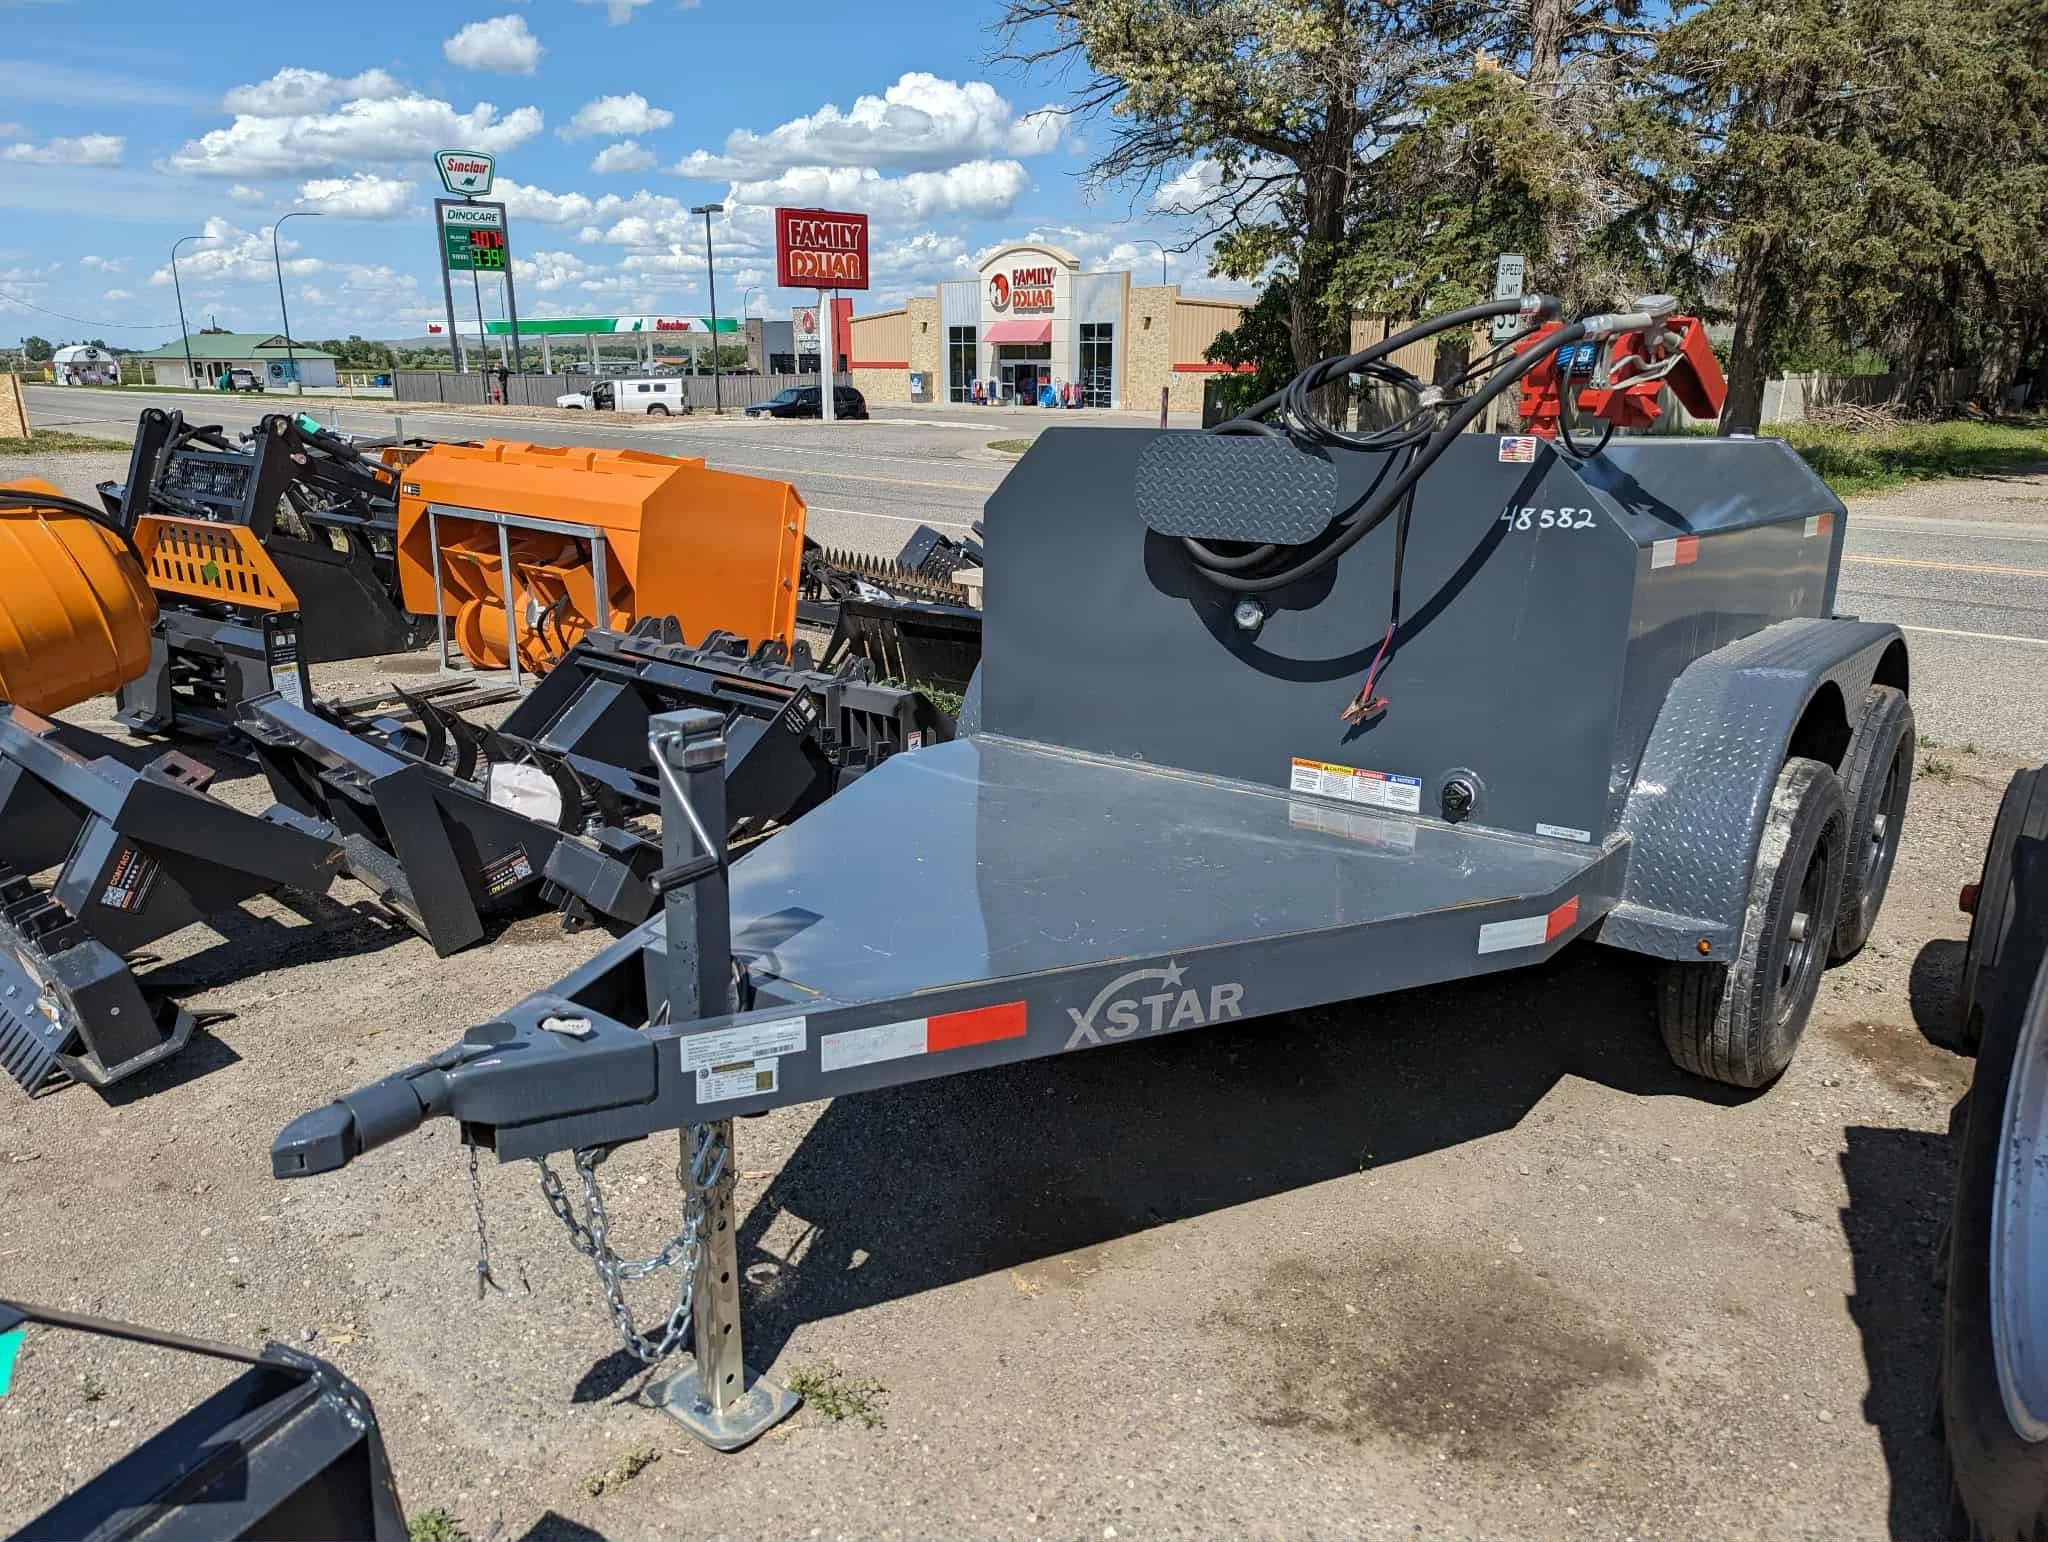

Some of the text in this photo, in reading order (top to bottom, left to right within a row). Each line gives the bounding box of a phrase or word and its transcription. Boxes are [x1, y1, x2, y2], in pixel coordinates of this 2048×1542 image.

[447, 158, 489, 174] Sinclair
[447, 208, 498, 222] DINOCARE
[788, 218, 862, 250] FAMILY
[790, 249, 862, 279] DOLLAR
[1501, 263, 1522, 276] SPEED
[1012, 267, 1054, 286] FAMILY
[1012, 288, 1053, 308] DOLLAR
[1501, 283, 1519, 297] LIMIT
[1500, 504, 1598, 532] 48582
